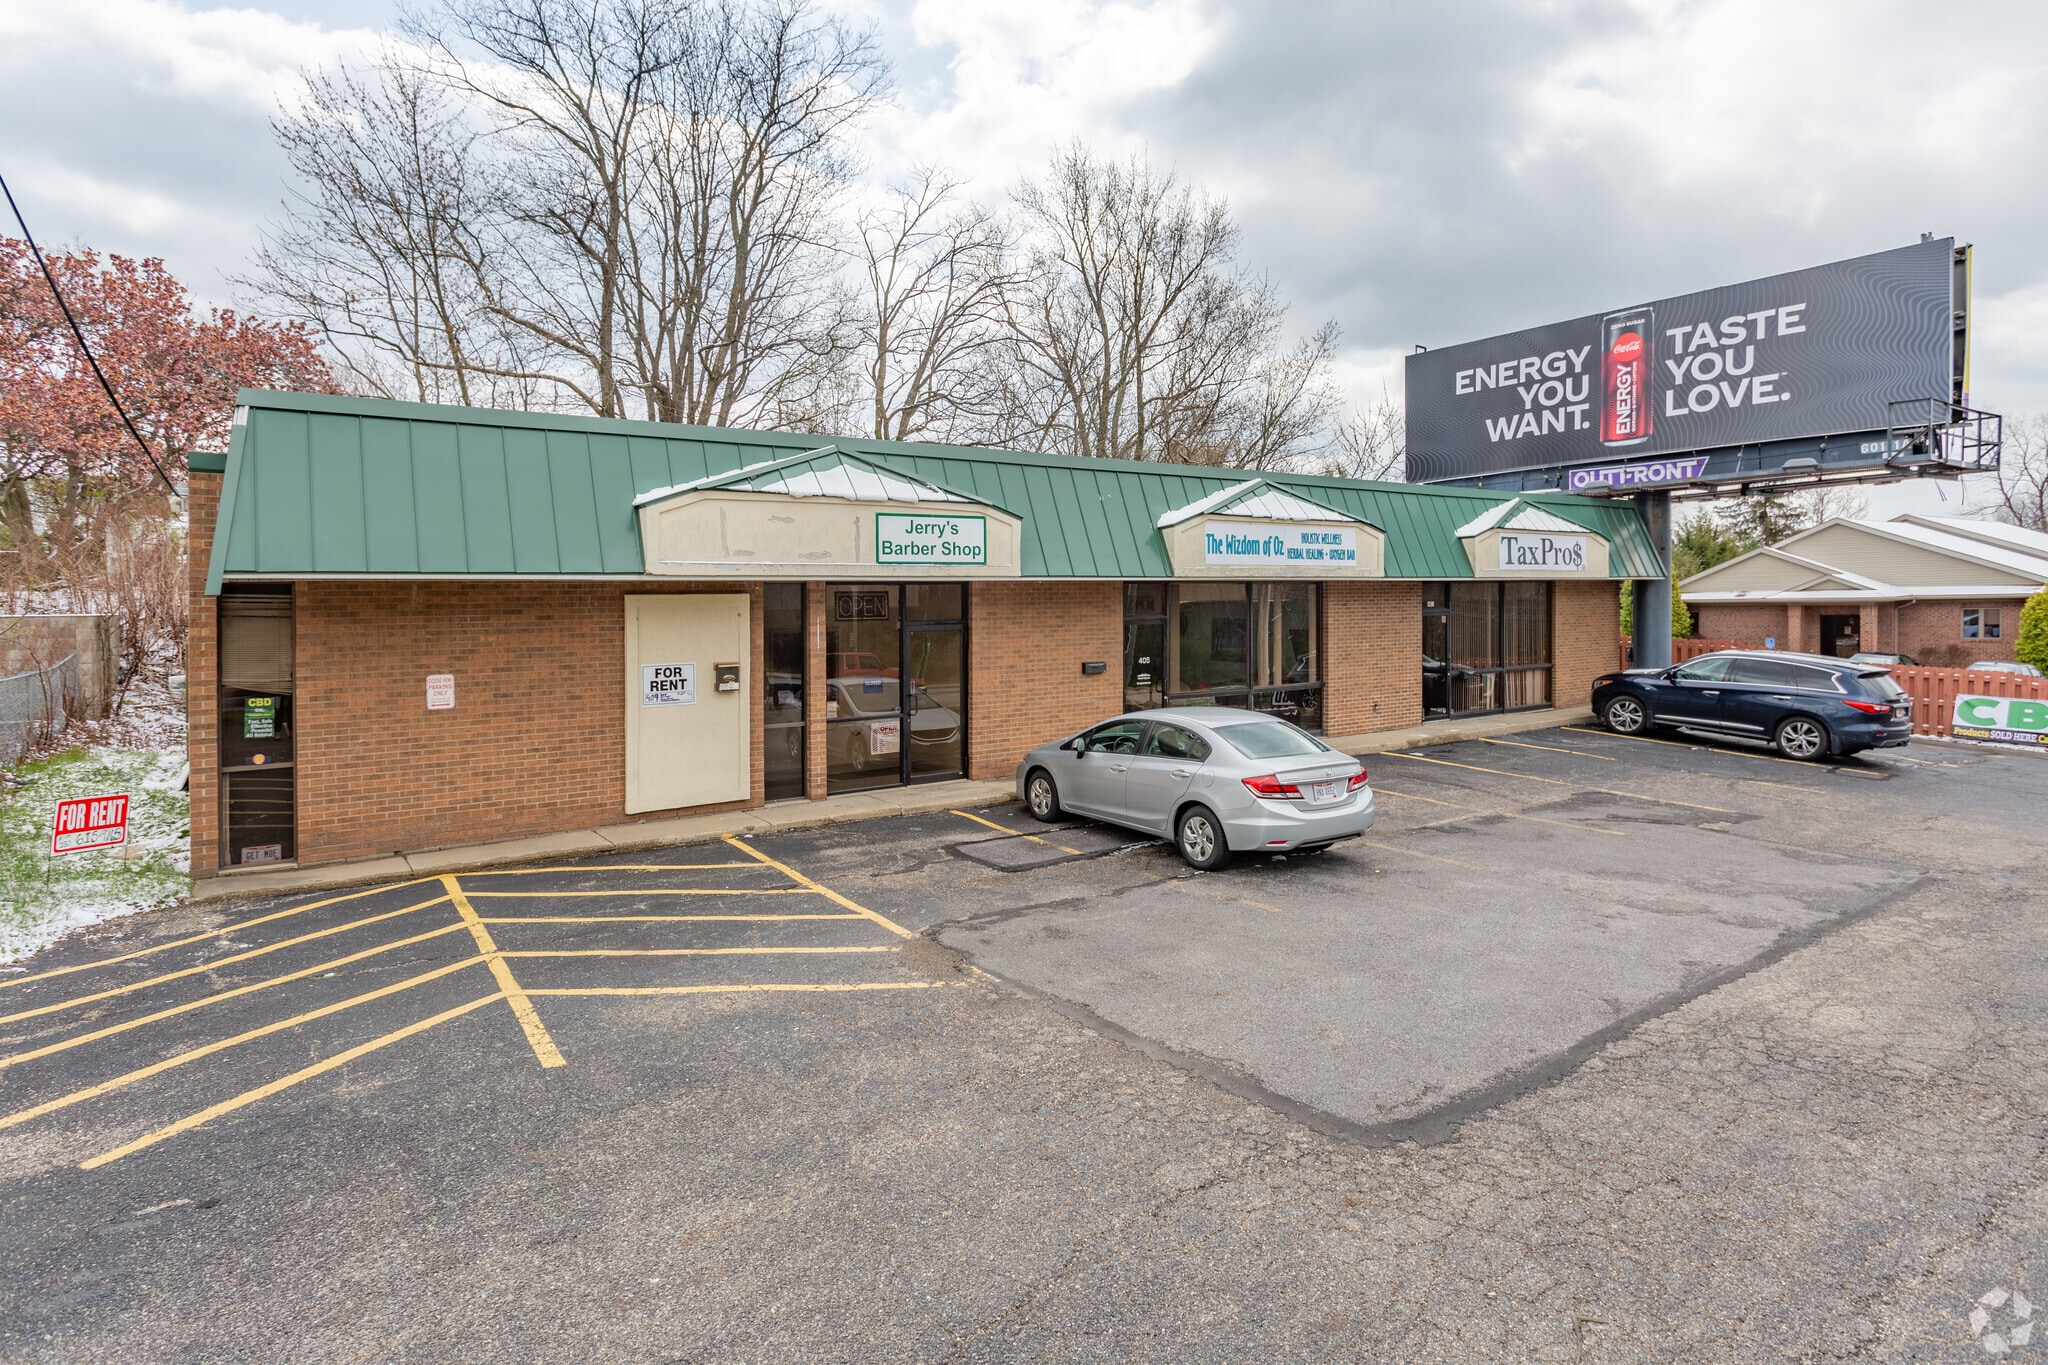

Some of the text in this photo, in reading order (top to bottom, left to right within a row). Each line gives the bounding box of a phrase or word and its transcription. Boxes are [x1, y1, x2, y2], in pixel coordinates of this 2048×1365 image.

[1626, 318, 1645, 327] SUGAR
[1666, 303, 1807, 355] TASTE
[1456, 345, 1592, 395] ENERGY
[1665, 345, 1755, 386] YOU
[1517, 374, 1590, 410] YOU
[1616, 364, 1632, 435] ENERGY
[1485, 403, 1591, 443] WANT.
[1573, 461, 1698, 488] OUTFRONT
[905, 520, 959, 539] Jerry's
[882, 540, 982, 560] Barber Shop
[1206, 533, 1284, 557] The Wizdom of Oz
[840, 597, 885, 616] OPEN
[1138, 656, 1151, 664] 405
[655, 667, 682, 679] FOR
[650, 679, 687, 692] RENT
[248, 697, 272, 707] CBD
[1953, 727, 1990, 738] Products
[1990, 730, 2013, 740] SOLD
[2013, 733, 2038, 743] HERE
[58, 798, 126, 832] FOR RENT
[246, 850, 259, 860] GET
